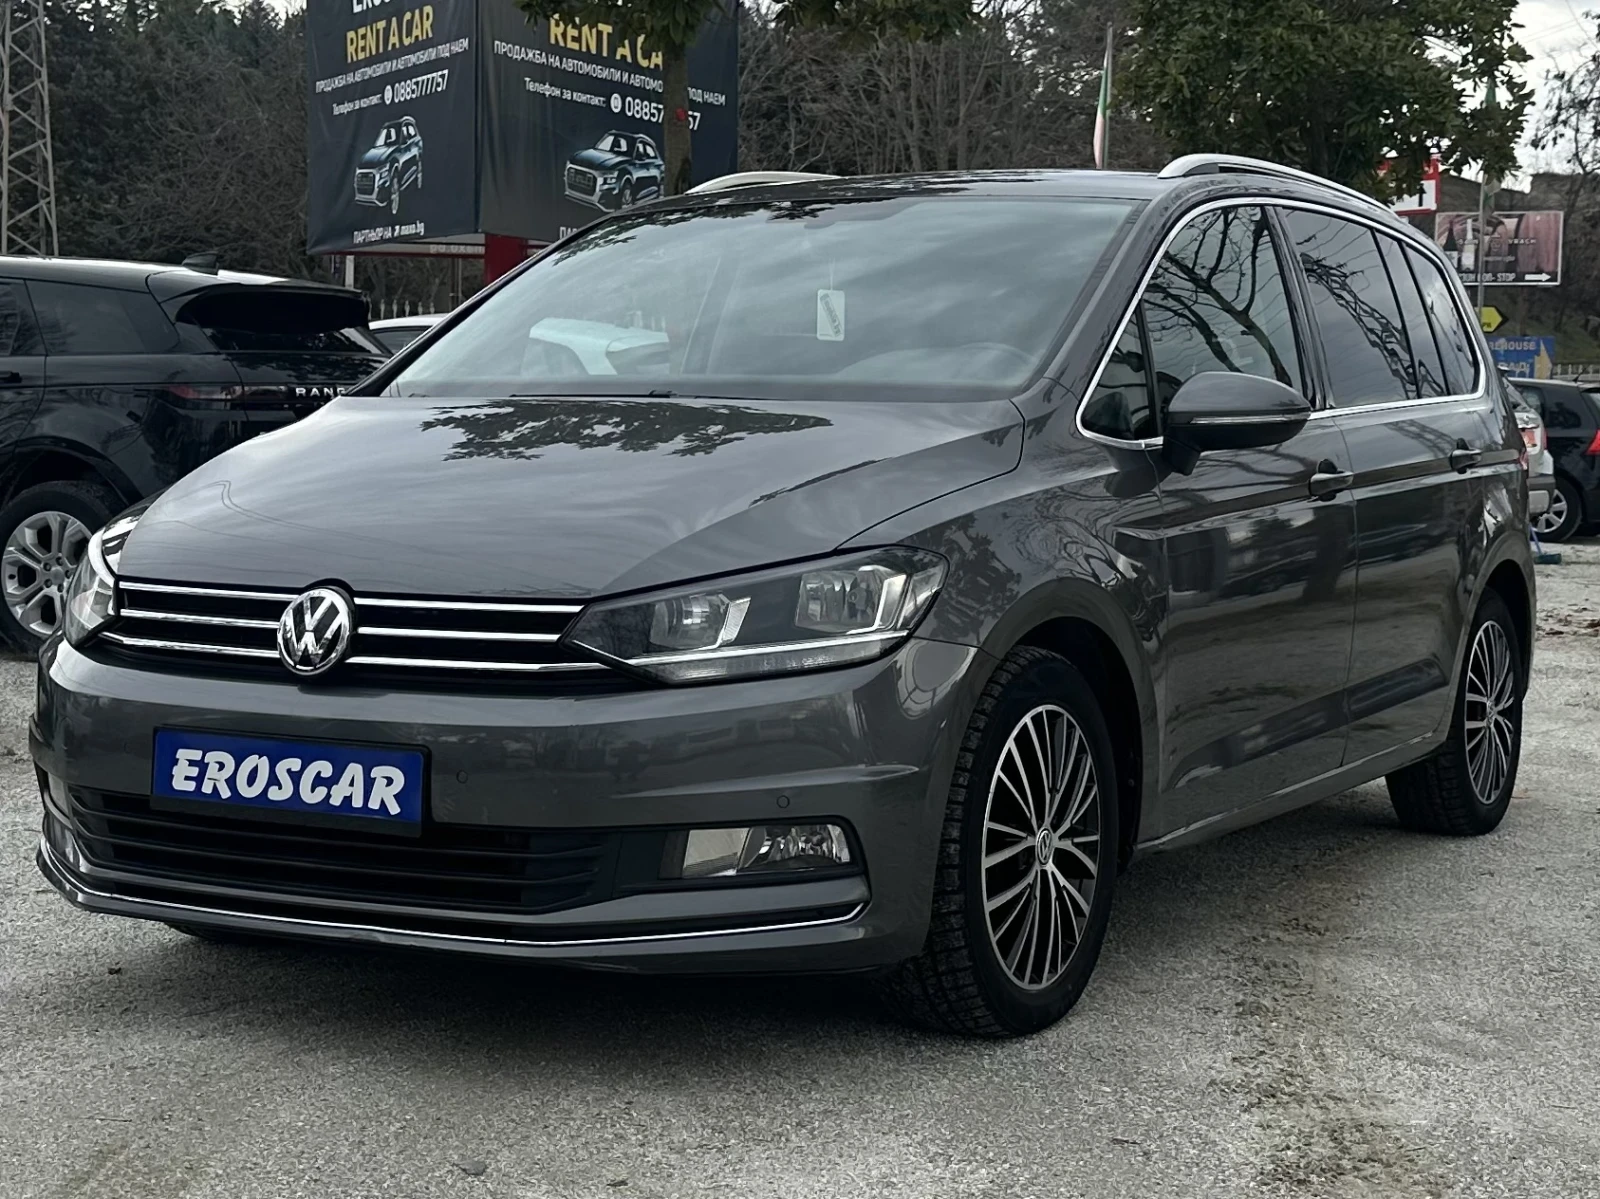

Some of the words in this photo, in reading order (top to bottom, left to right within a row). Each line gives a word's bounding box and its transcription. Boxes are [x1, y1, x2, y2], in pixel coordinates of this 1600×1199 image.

[346, 20, 387, 63] RENT
[388, 17, 400, 51] A
[402, 5, 434, 47] CAR
[452, 37, 469, 52] НАЕМ
[550, 16, 613, 57] RENT
[394, 68, 449, 103] 0885777757
[494, 40, 548, 66] ПРОДАЖБА
[548, 53, 561, 68] НА
[561, 57, 621, 84] АВТОМОБИЛИ
[621, 72, 629, 84] И
[703, 90, 726, 107] НАЕМ
[524, 77, 561, 97] Телефон
[562, 89, 572, 101] за
[572, 91, 607, 108] контакт:
[296, 387, 347, 397] RANG
[171, 748, 405, 816] EROSCAR
